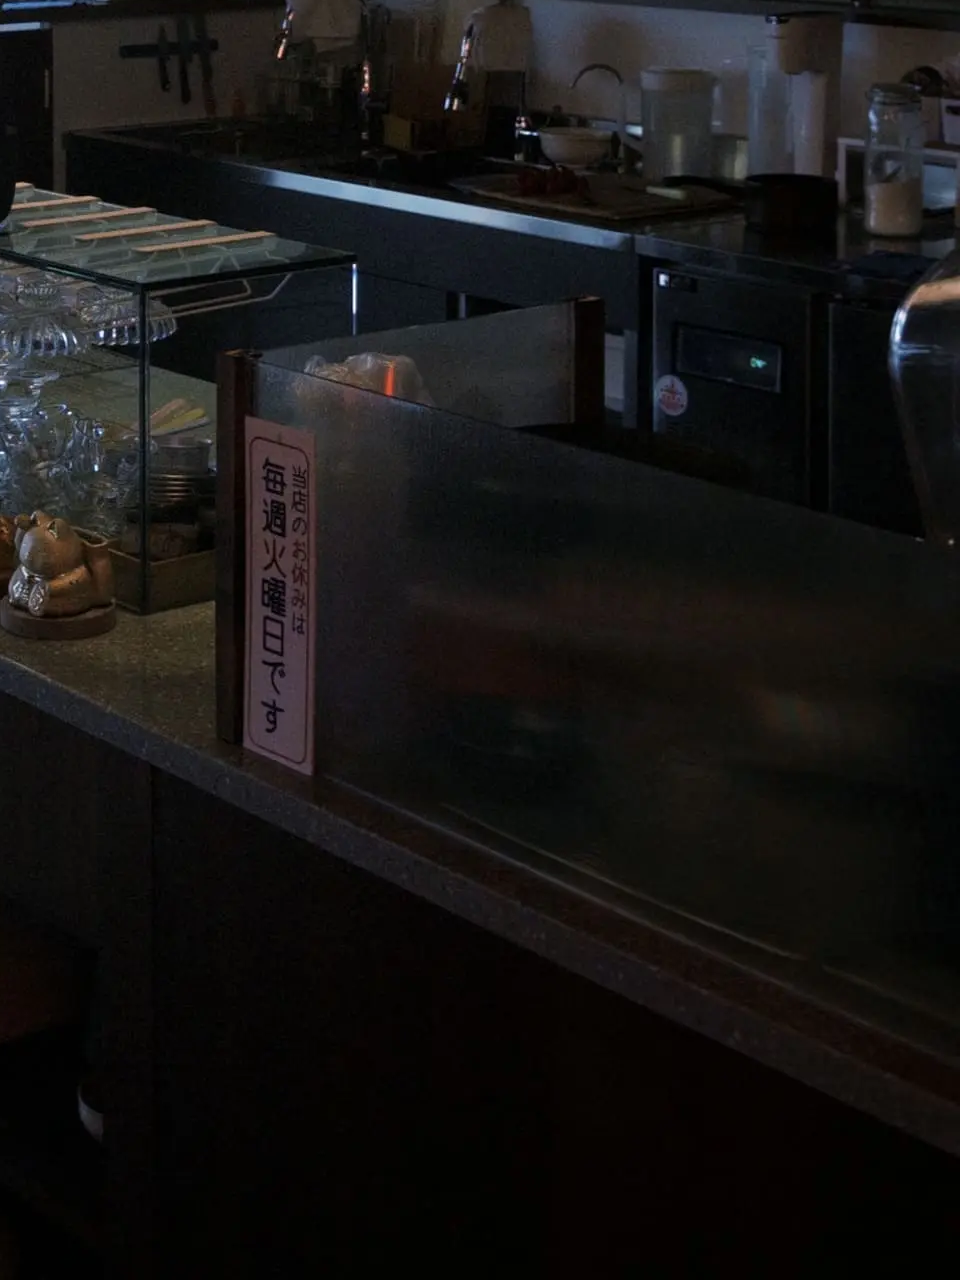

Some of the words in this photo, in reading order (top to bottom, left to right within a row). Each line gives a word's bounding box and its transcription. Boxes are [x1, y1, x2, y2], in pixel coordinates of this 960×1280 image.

[261, 456, 287, 733] 毎週火曜日です
[291, 464, 308, 635] 当店のお休みは
